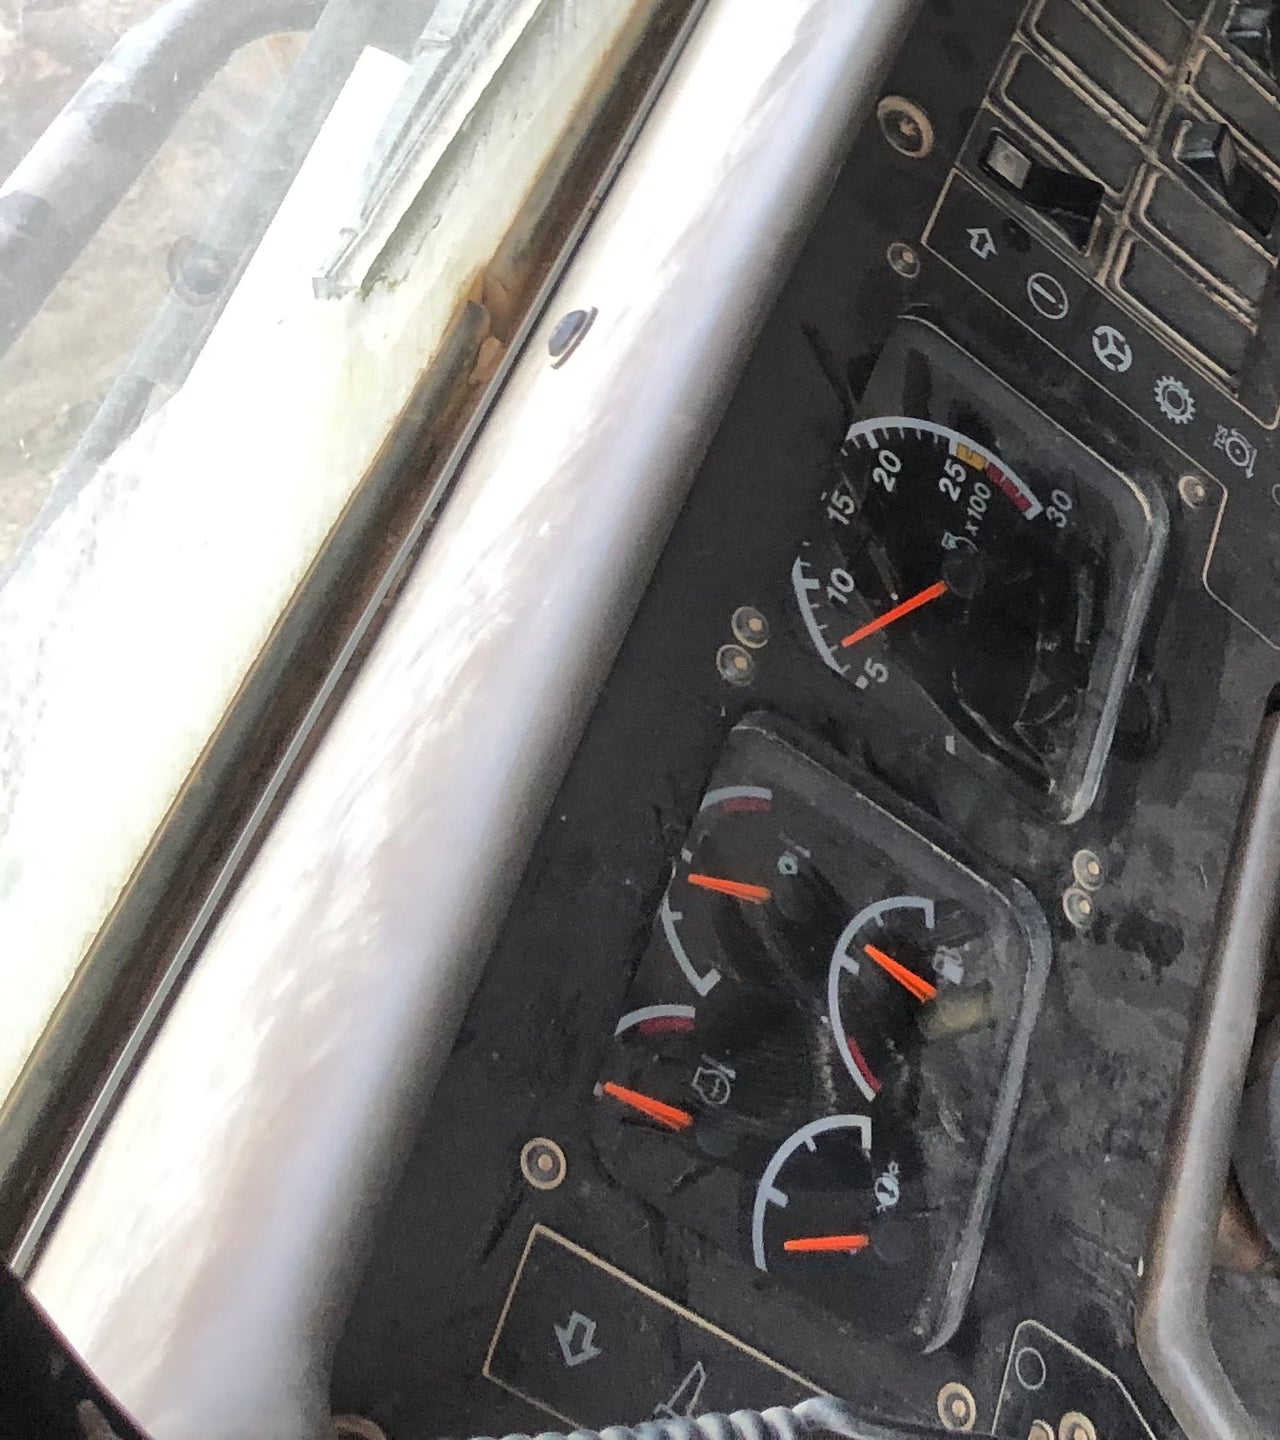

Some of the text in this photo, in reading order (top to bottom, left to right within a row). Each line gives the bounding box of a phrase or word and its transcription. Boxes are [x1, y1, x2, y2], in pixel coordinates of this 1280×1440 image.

[872, 450, 902, 494] 20
[938, 459, 967, 502] 25
[827, 493, 856, 526] 15
[965, 483, 993, 537] x100
[1046, 489, 1074, 529] 30
[827, 567, 855, 606] 10
[865, 658, 889, 684] 5
